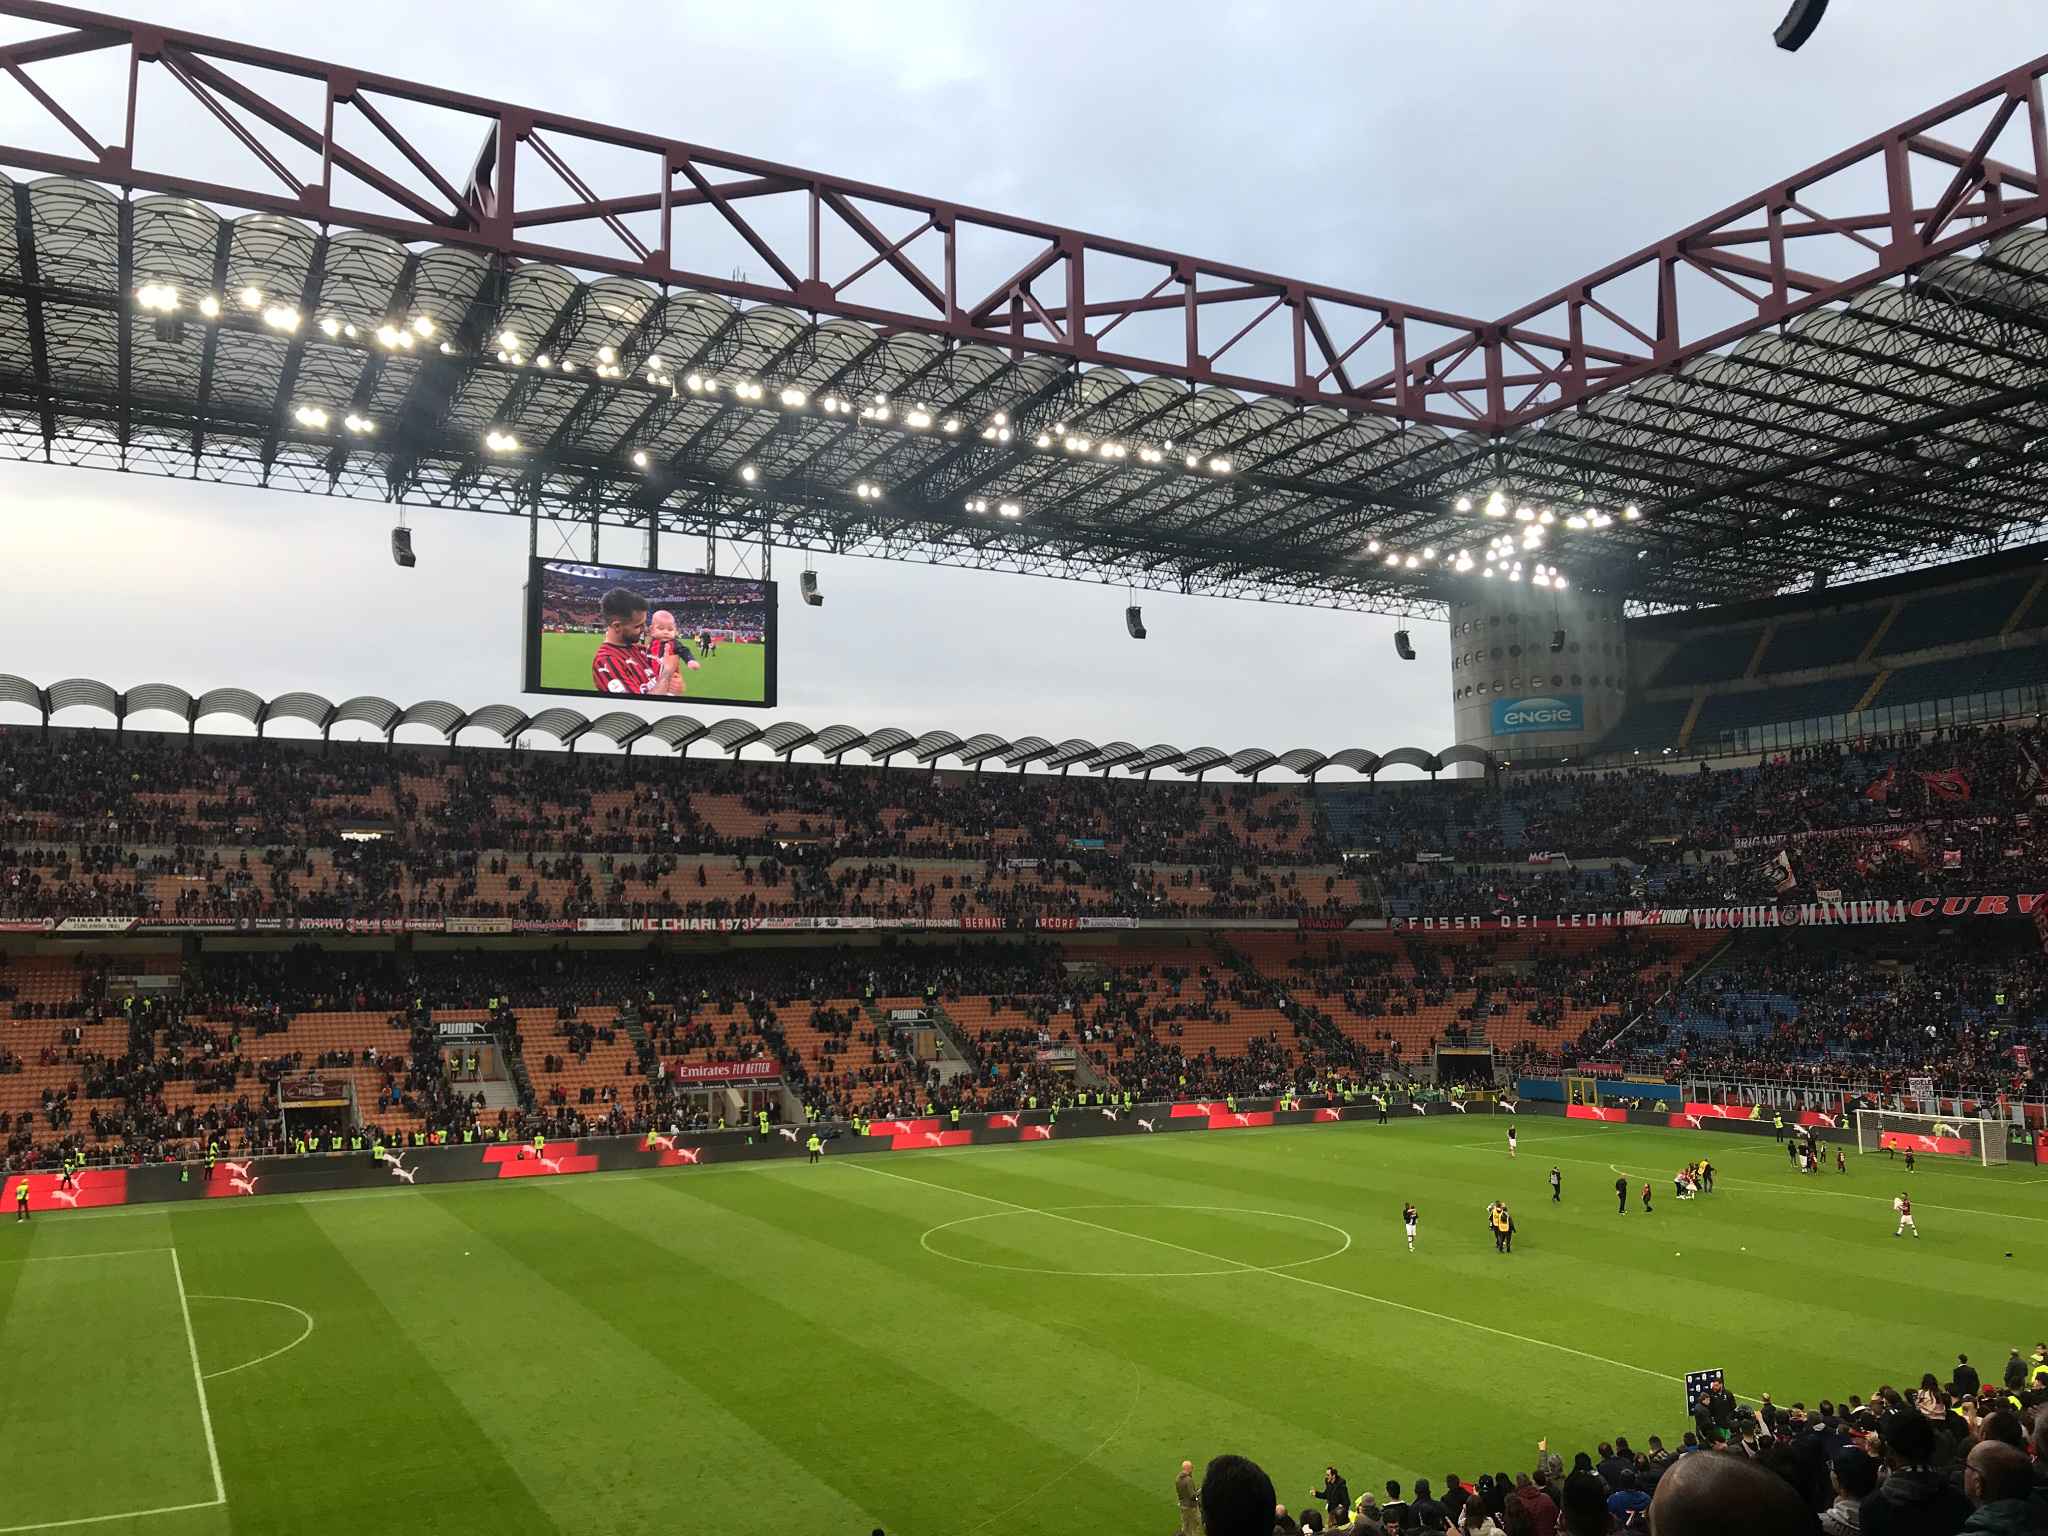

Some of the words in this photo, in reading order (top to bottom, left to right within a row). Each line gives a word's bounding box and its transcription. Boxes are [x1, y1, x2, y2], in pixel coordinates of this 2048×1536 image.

[1692, 905, 1780, 930] VECCHIA
[1800, 899, 1907, 926] MANIERA
[300, 917, 344, 930] KOSOVO
[355, 919, 379, 929] MILAN
[382, 918, 402, 929] CLUB
[720, 918, 749, 930] 1973
[965, 917, 1007, 928] BERNATE
[1034, 917, 1075, 928] ARCORE
[1408, 915, 1481, 930] FOSSA
[1501, 915, 1538, 928] DEI
[1557, 912, 1621, 927] LEONI
[892, 1009, 918, 1020] PUMA
[440, 1022, 474, 1034] PUMA
[680, 1065, 730, 1078] Emirates
[732, 1063, 745, 1075] FLY
[745, 1062, 770, 1075] BETTER
